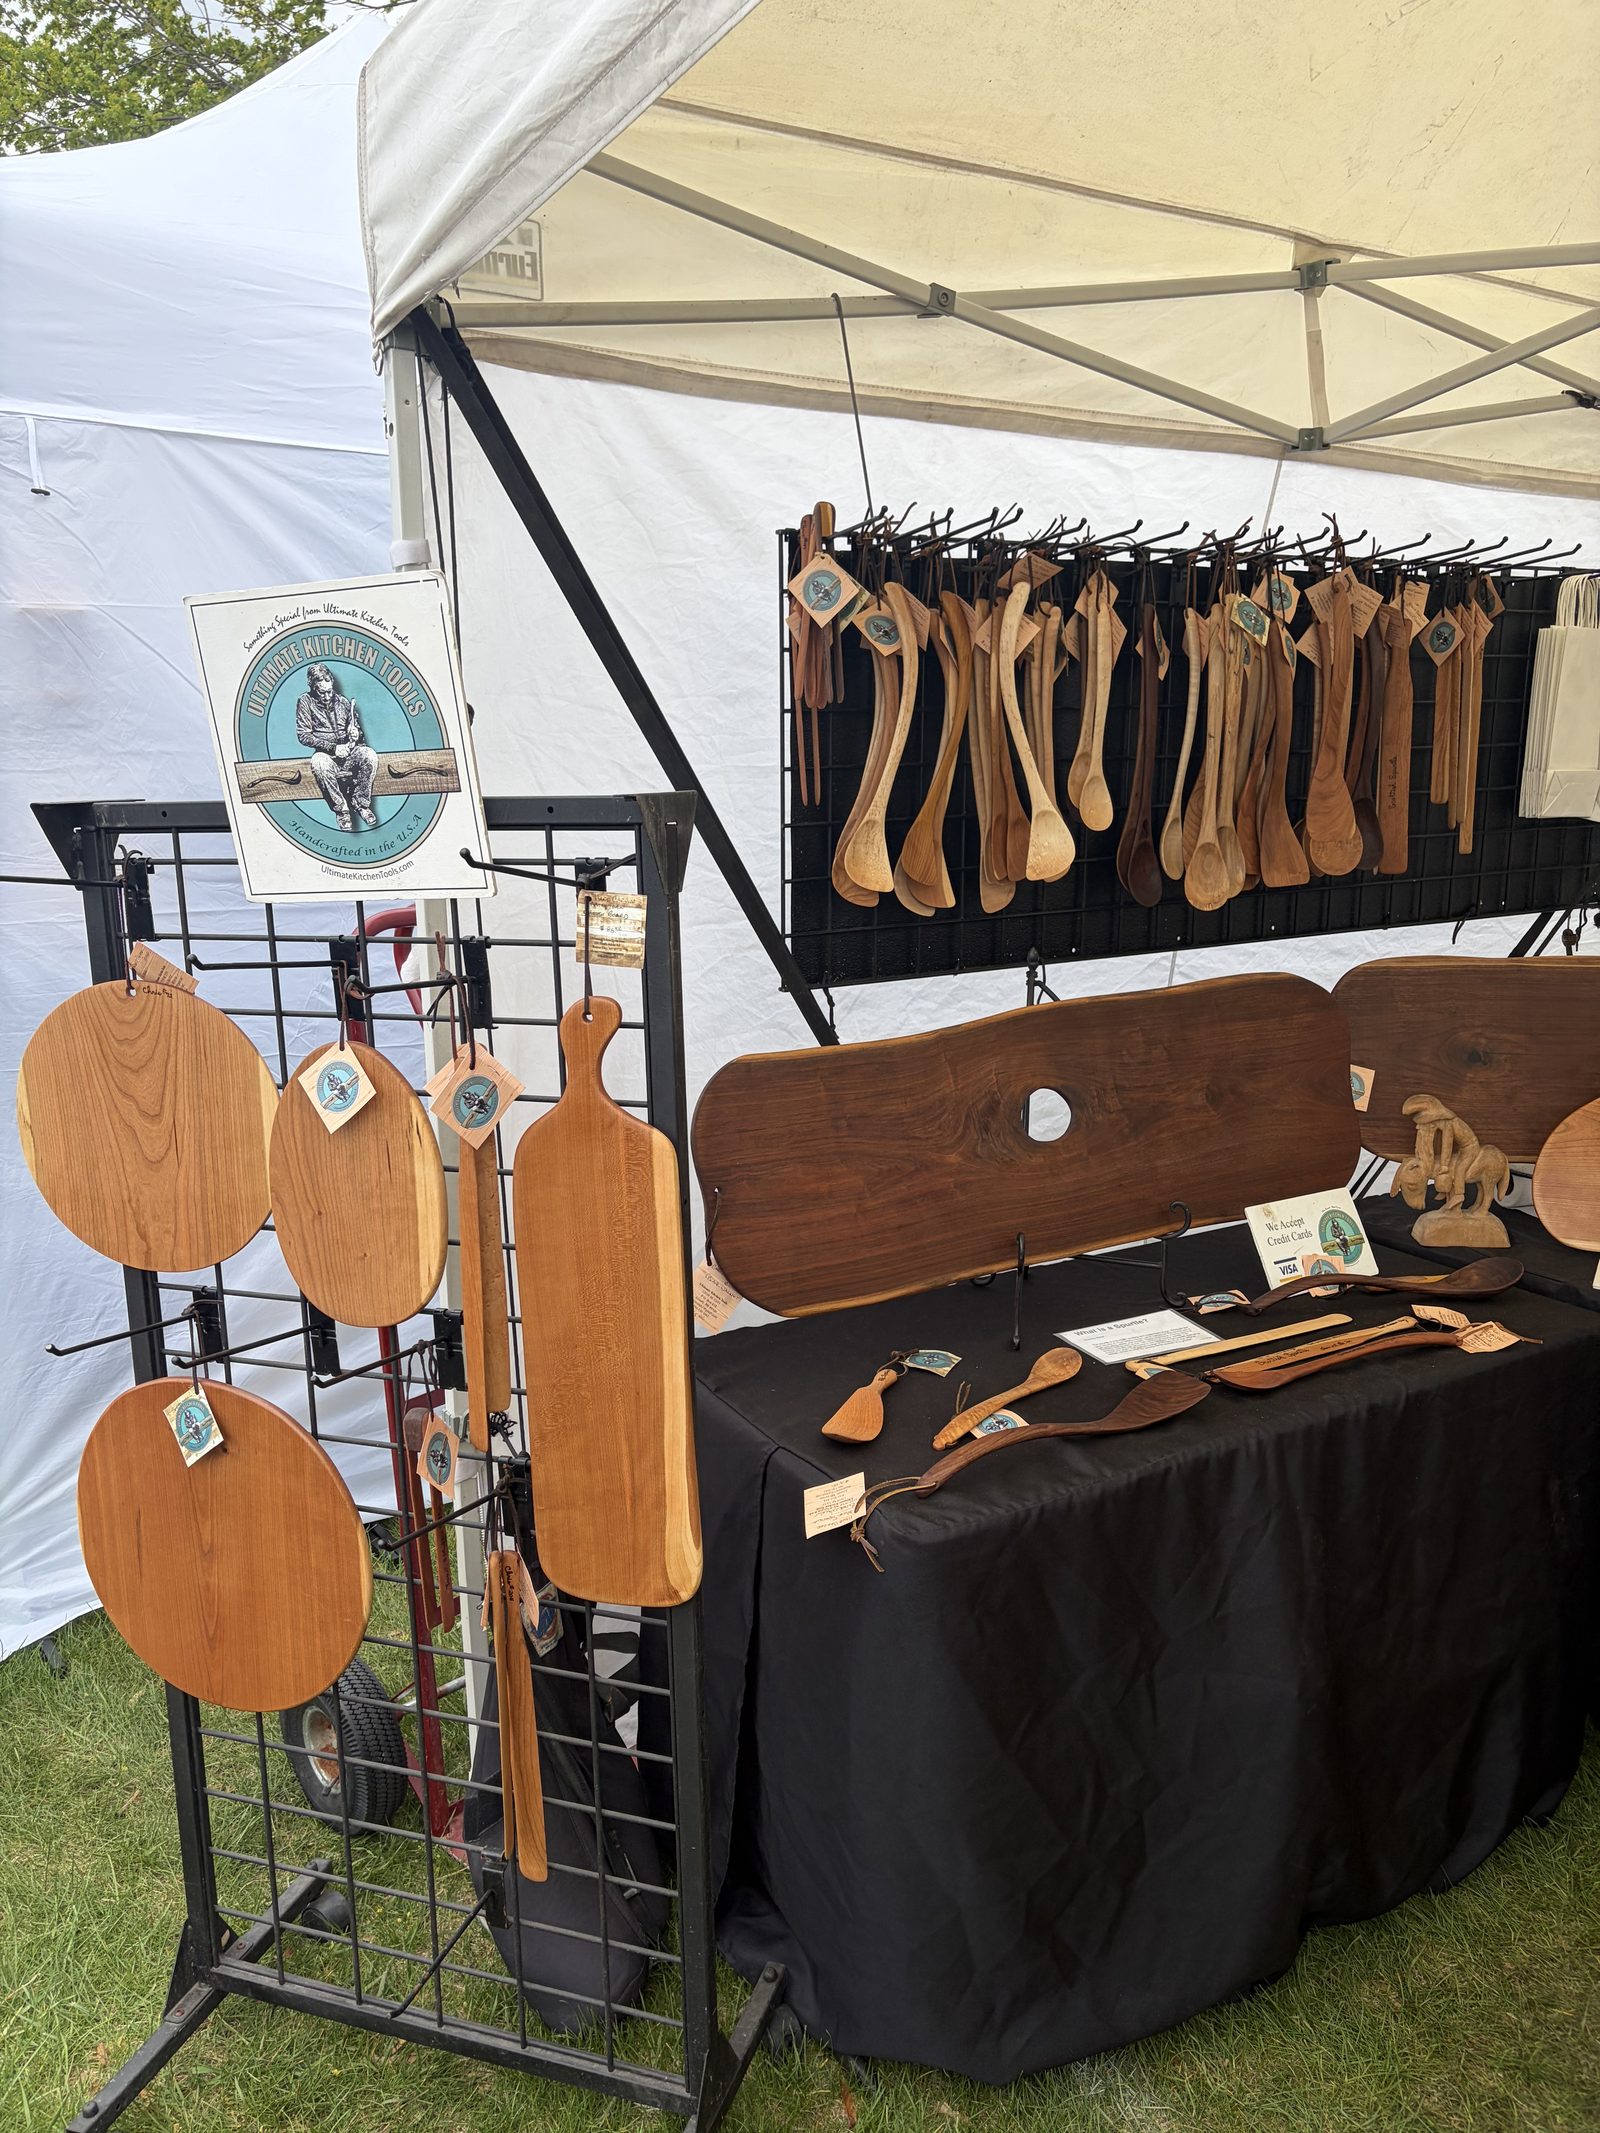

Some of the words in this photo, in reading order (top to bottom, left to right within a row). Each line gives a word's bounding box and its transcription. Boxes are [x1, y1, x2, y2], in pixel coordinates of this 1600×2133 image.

[243, 622, 277, 653] Something
[274, 606, 301, 628] Special
[302, 606, 321, 620] from
[323, 602, 358, 618] Ultimate
[360, 605, 389, 632] Kitchen
[390, 620, 409, 647] Tools
[247, 641, 303, 718] ULTIMATE
[301, 634, 379, 670] KITCHEN
[378, 656, 426, 717] TOOLS
[288, 818, 363, 857] Handcrafted
[364, 848, 377, 856] in
[379, 840, 396, 853] the
[320, 859, 415, 881] UltimateKitchenTools.com
[1265, 1221, 1280, 1232] We
[1280, 1216, 1305, 1229] Accept
[1267, 1233, 1291, 1247] Credit
[1291, 1228, 1313, 1241] Cards
[1279, 1263, 1299, 1276] VISA
